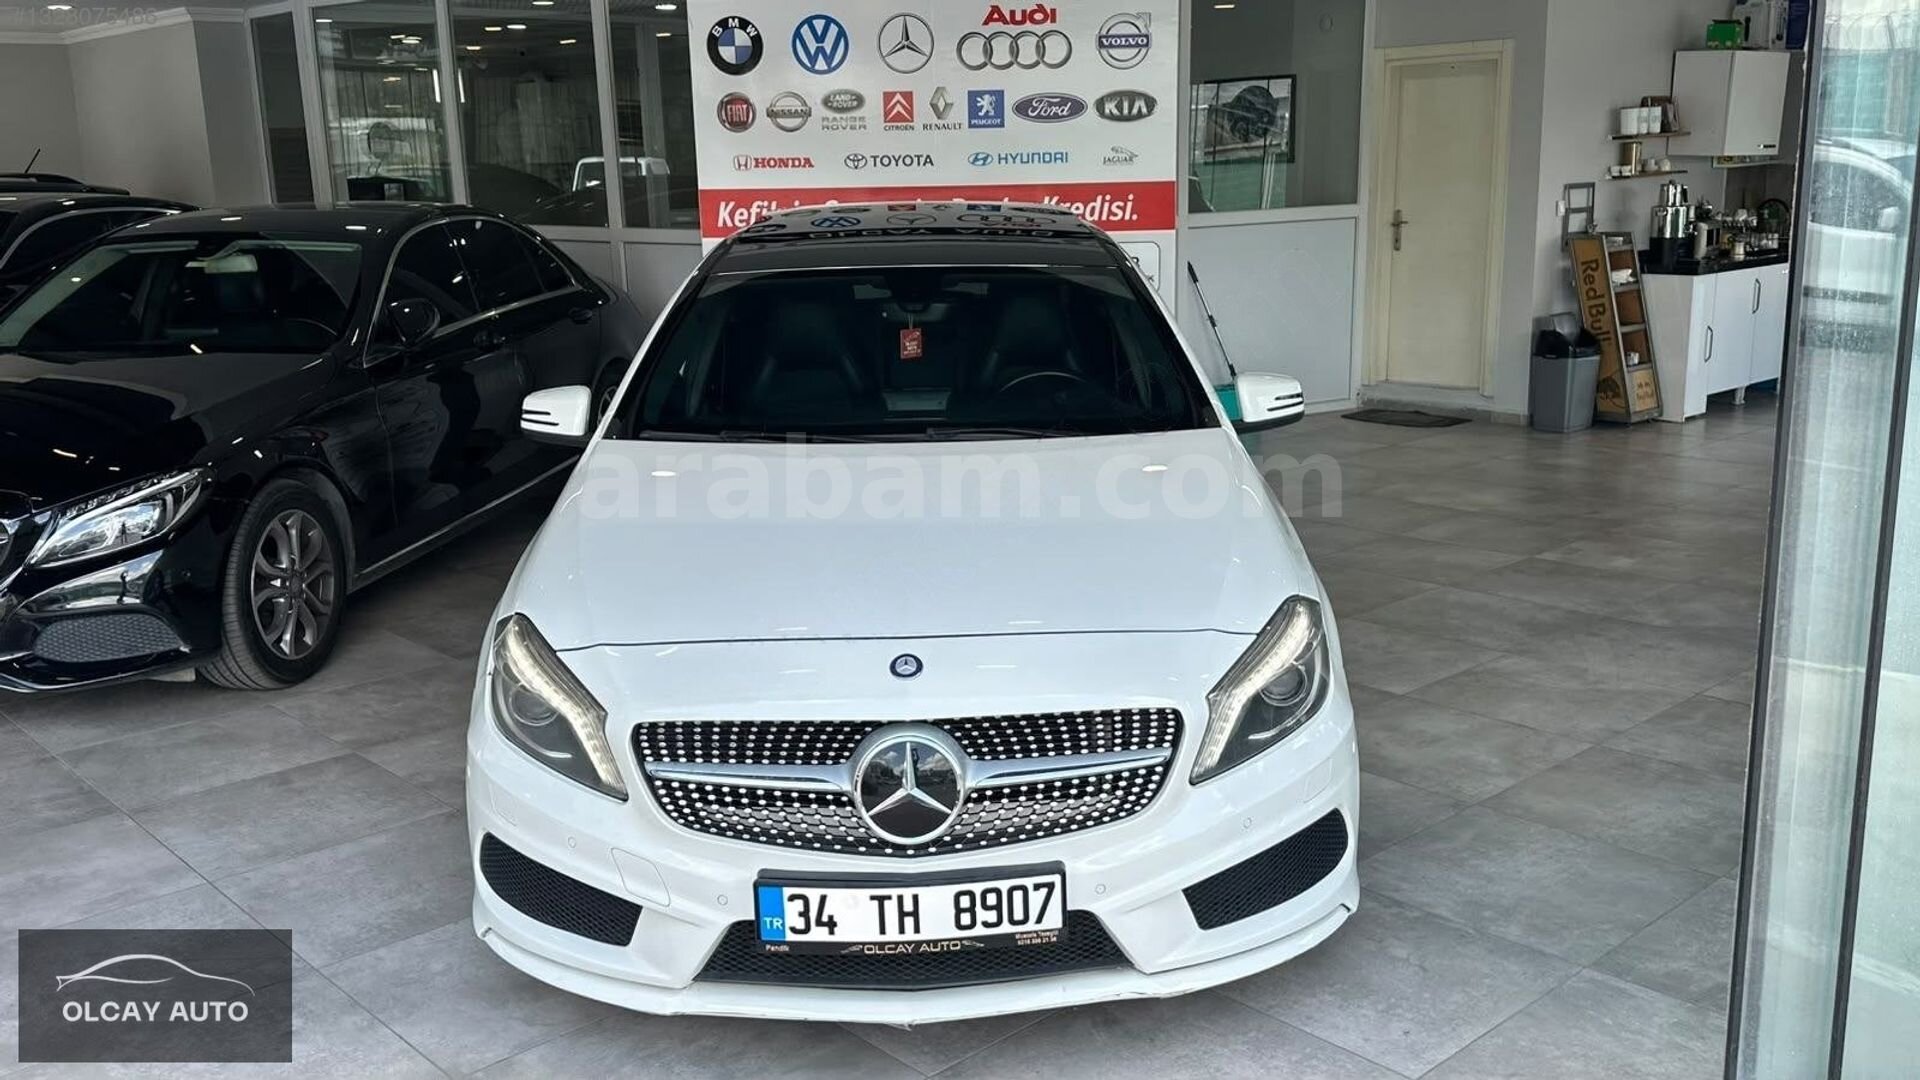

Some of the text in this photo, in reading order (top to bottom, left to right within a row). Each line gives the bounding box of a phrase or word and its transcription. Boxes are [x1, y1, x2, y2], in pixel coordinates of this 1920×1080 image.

[982, 4, 1057, 26] Audi
[712, 18, 758, 37] BMW
[1100, 36, 1148, 46] VOLVO
[727, 104, 747, 122] FIAT
[770, 108, 809, 116] NISSAN
[1028, 98, 1072, 117] Ford
[1104, 98, 1148, 116] KIA
[922, 122, 963, 131] RENAULT
[754, 157, 814, 169] HONDA
[870, 154, 934, 167] TOYOTA
[998, 152, 1068, 165] HYUNDAI
[1102, 156, 1133, 165] JAGUAR
[1581, 258, 1605, 301] Red
[787, 881, 1056, 935] 34 TH 8907
[764, 917, 783, 930] TR
[864, 940, 961, 954] OLCAY AUTO
